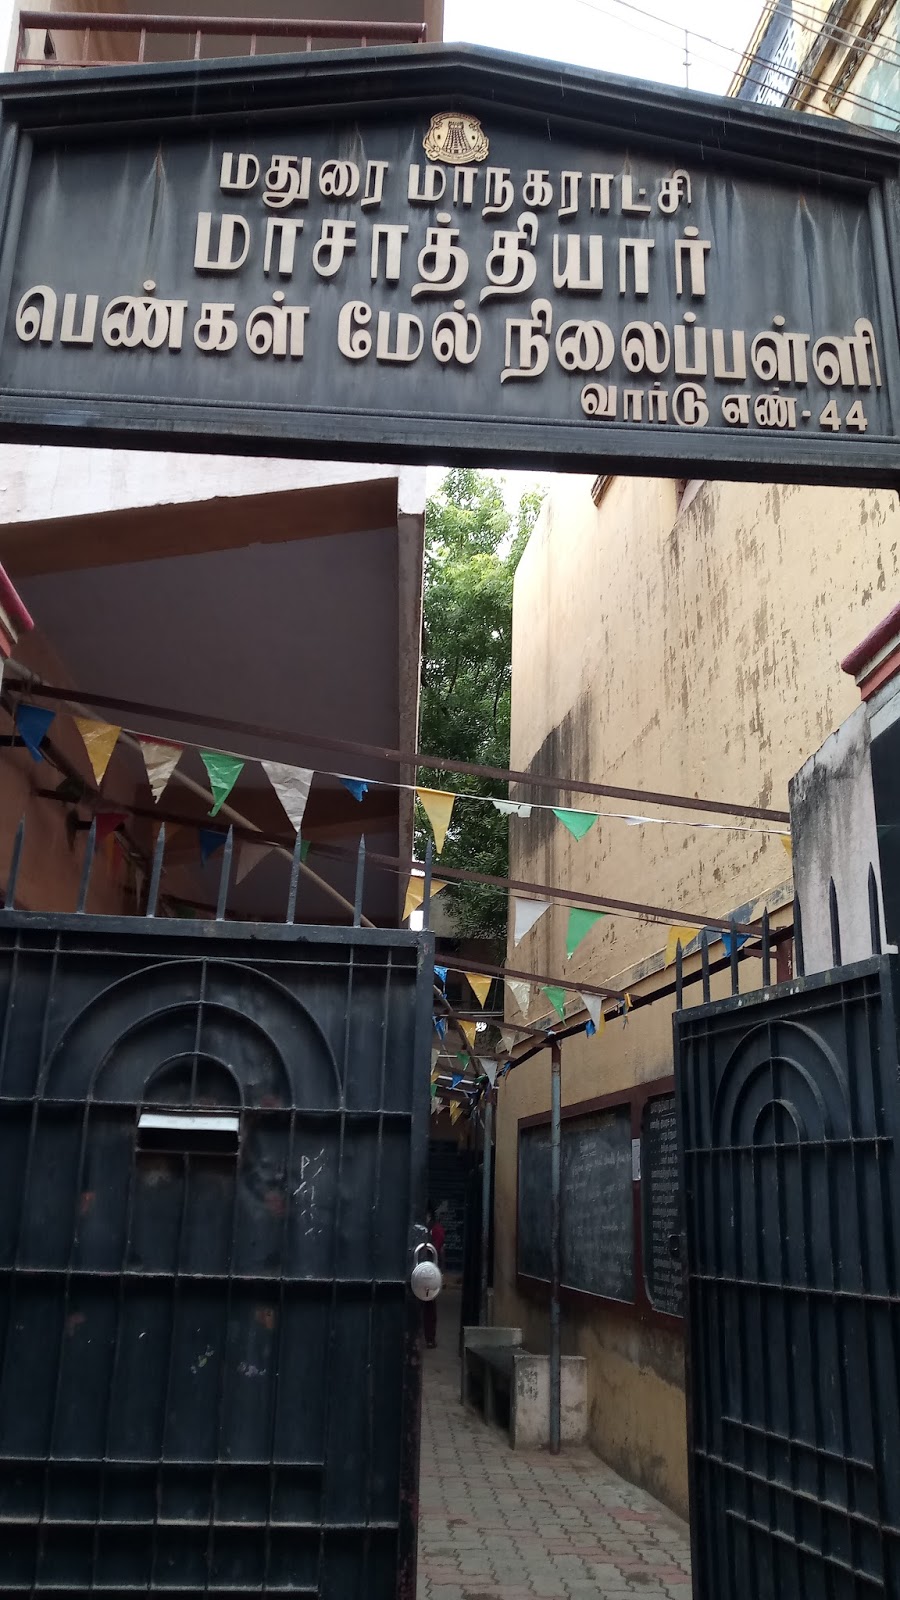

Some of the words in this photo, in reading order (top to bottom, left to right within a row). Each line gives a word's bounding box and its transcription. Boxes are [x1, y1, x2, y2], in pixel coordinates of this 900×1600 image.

[220, 152, 389, 209] மதுரை
[407, 164, 692, 216] மாநகராட்சி
[194, 211, 712, 303] மாசாத்தியார்
[15, 279, 310, 356] பெண்கள்
[580, 381, 709, 428] வார்டு
